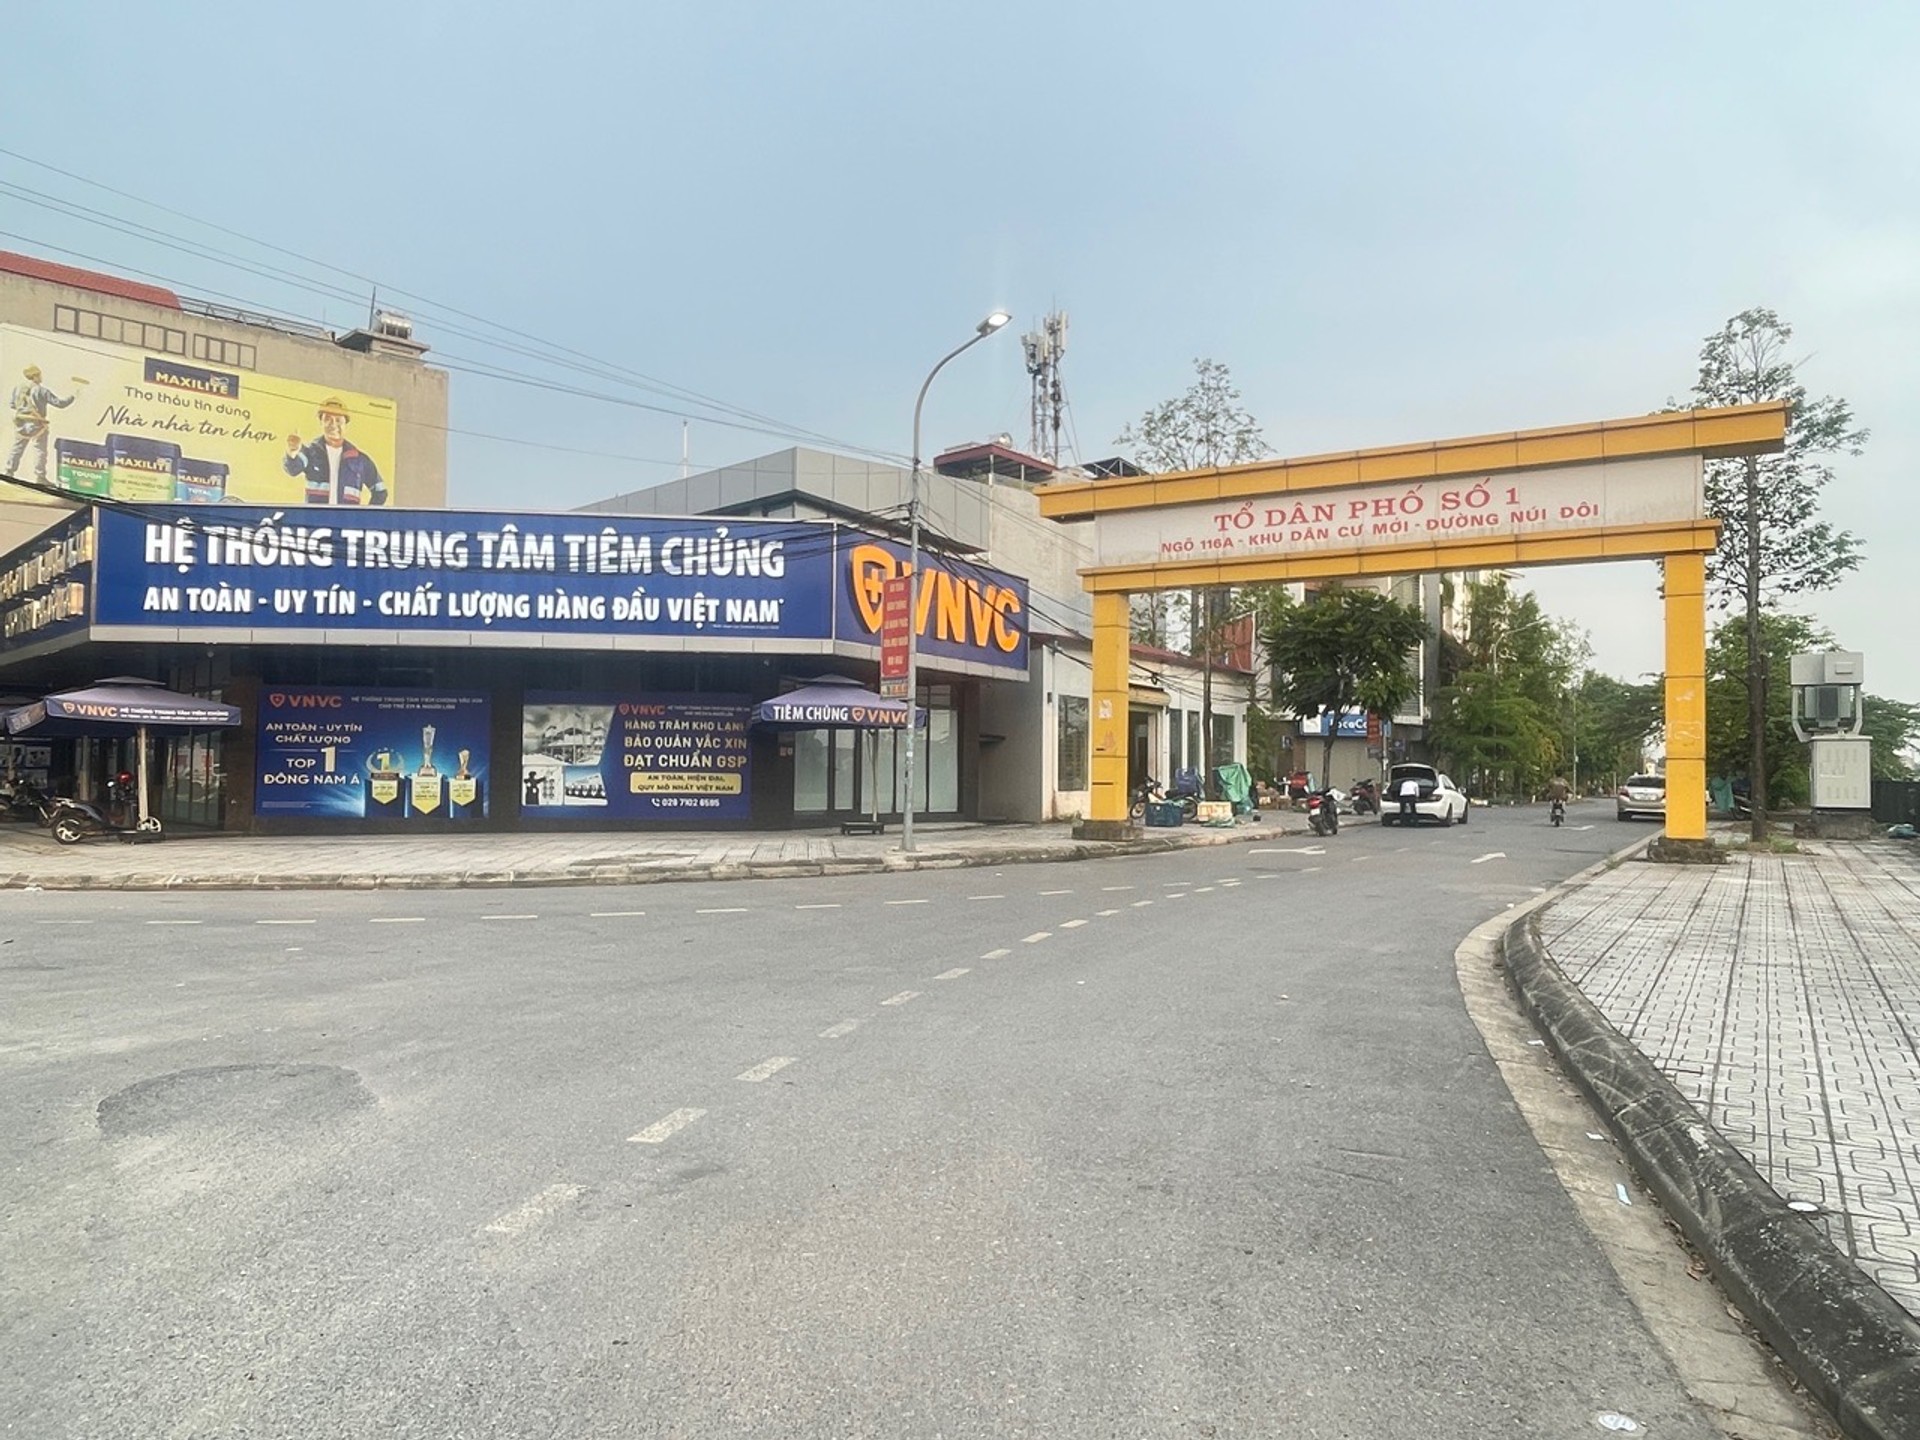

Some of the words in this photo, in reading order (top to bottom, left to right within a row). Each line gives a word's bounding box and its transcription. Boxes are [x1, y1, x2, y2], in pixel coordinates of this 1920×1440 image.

[155, 371, 229, 395] MAXILITE
[96, 404, 147, 427] Nhà
[152, 414, 194, 432] nhà
[61, 456, 109, 469] MAXILITE
[113, 456, 172, 473] MAXILITE
[177, 474, 222, 487] MAXILITE
[1215, 501, 1255, 532] TỔ
[1265, 502, 1336, 528] DÂN
[1348, 484, 1424, 518] PHỐ
[1441, 477, 1491, 511] SỐ
[1506, 487, 1520, 505] 1
[1162, 537, 1194, 553] NGÕ
[1200, 538, 1234, 550] 116A
[1249, 533, 1283, 546] KHU
[1291, 526, 1329, 541] DÂN
[1338, 524, 1364, 538] CƯ
[1373, 518, 1408, 535] MỚI
[1426, 512, 1499, 531] ĐƯỜNG
[1510, 506, 1547, 523] NÚI
[144, 516, 197, 573] HỆ
[202, 511, 334, 567] THỐNG
[340, 527, 468, 570] TRUNG
[477, 523, 556, 570] TÂM
[562, 526, 653, 574] TIÊM
[661, 526, 786, 577] CHỦNG
[143, 586, 179, 612] AN
[186, 581, 252, 612] TOÀN
[274, 589, 307, 614] UY
[313, 583, 356, 615] TÍN
[362, 599, 372, 607] -
[378, 582, 442, 617] CHẤT
[448, 590, 530, 624] LƯỢNG
[537, 588, 606, 620] HÀNG
[612, 586, 661, 621] ĐẦU
[666, 592, 720, 629] VIỆT
[902, 560, 1021, 653] VNVC
[77, 703, 118, 717] VNVC
[288, 695, 342, 708] VNVC
[631, 704, 666, 715] VNVC
[772, 703, 806, 720] TIÊM
[806, 704, 848, 721] CHỦNG
[265, 722, 283, 731] AN
[286, 721, 317, 731] TOÀN
[326, 724, 343, 732] UY
[343, 722, 363, 732] TÍN
[625, 719, 656, 731] HÀNG
[692, 721, 715, 731] KHO
[275, 732, 307, 743] CHẤT
[309, 734, 351, 746] LƯỢNG
[624, 733, 651, 748] BẢO
[655, 733, 692, 749] QUẢN
[695, 733, 721, 748] VẮC
[725, 738, 747, 749] XIN
[286, 758, 316, 768] TOP
[320, 746, 337, 772] 1
[623, 754, 654, 770] ĐẠT
[658, 749, 712, 767] CHUẨN
[716, 756, 747, 768] GSP
[263, 772, 310, 785] ĐÔNG
[314, 775, 346, 785] NAM
[350, 773, 360, 785] Á
